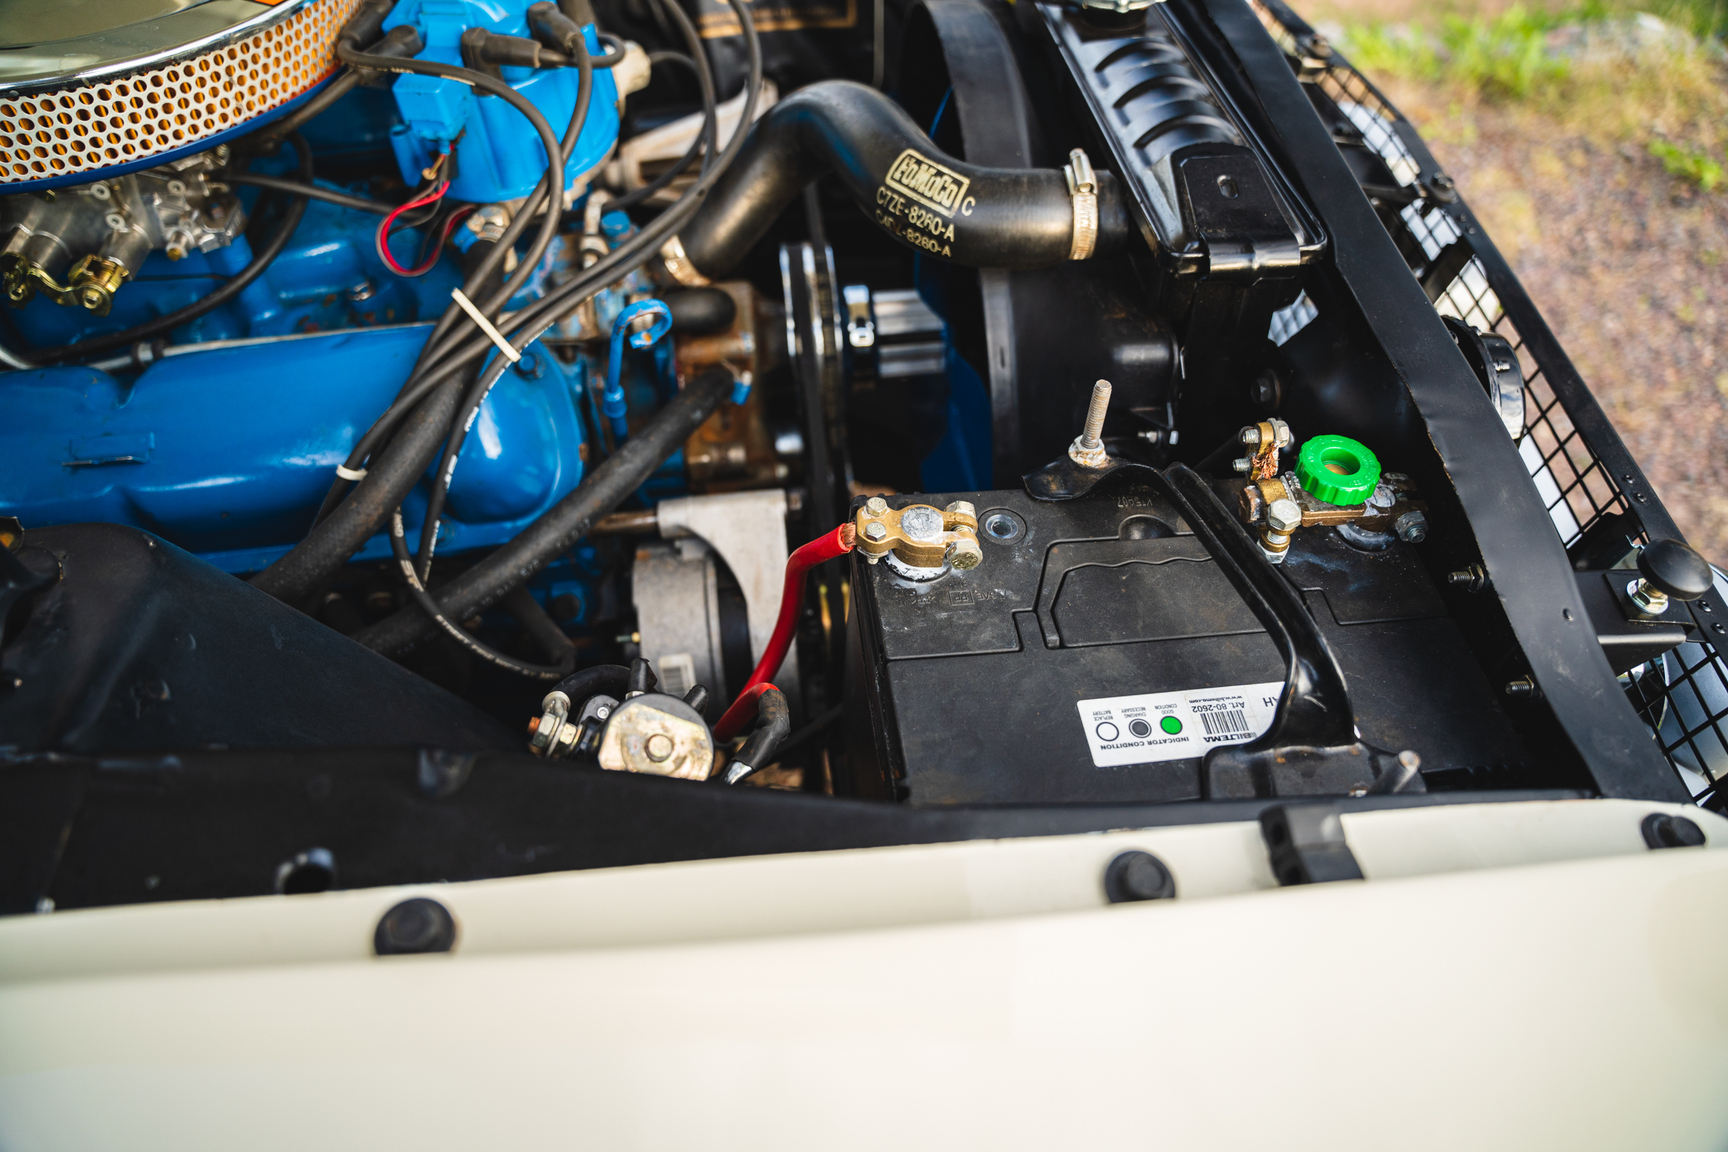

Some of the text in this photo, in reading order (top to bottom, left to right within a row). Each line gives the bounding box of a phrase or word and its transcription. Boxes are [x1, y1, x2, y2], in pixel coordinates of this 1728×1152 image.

[961, 196, 976, 216] C
[876, 185, 955, 242] C7ZE-8260-A
[1188, 695, 1243, 704] www.biltema.com
[1191, 701, 1245, 713] Art. 80-2602
[1124, 711, 1146, 719] CHARGING
[1100, 736, 1190, 751] INDICATOR CONDITION
[1203, 732, 1252, 743] BILTEMA
